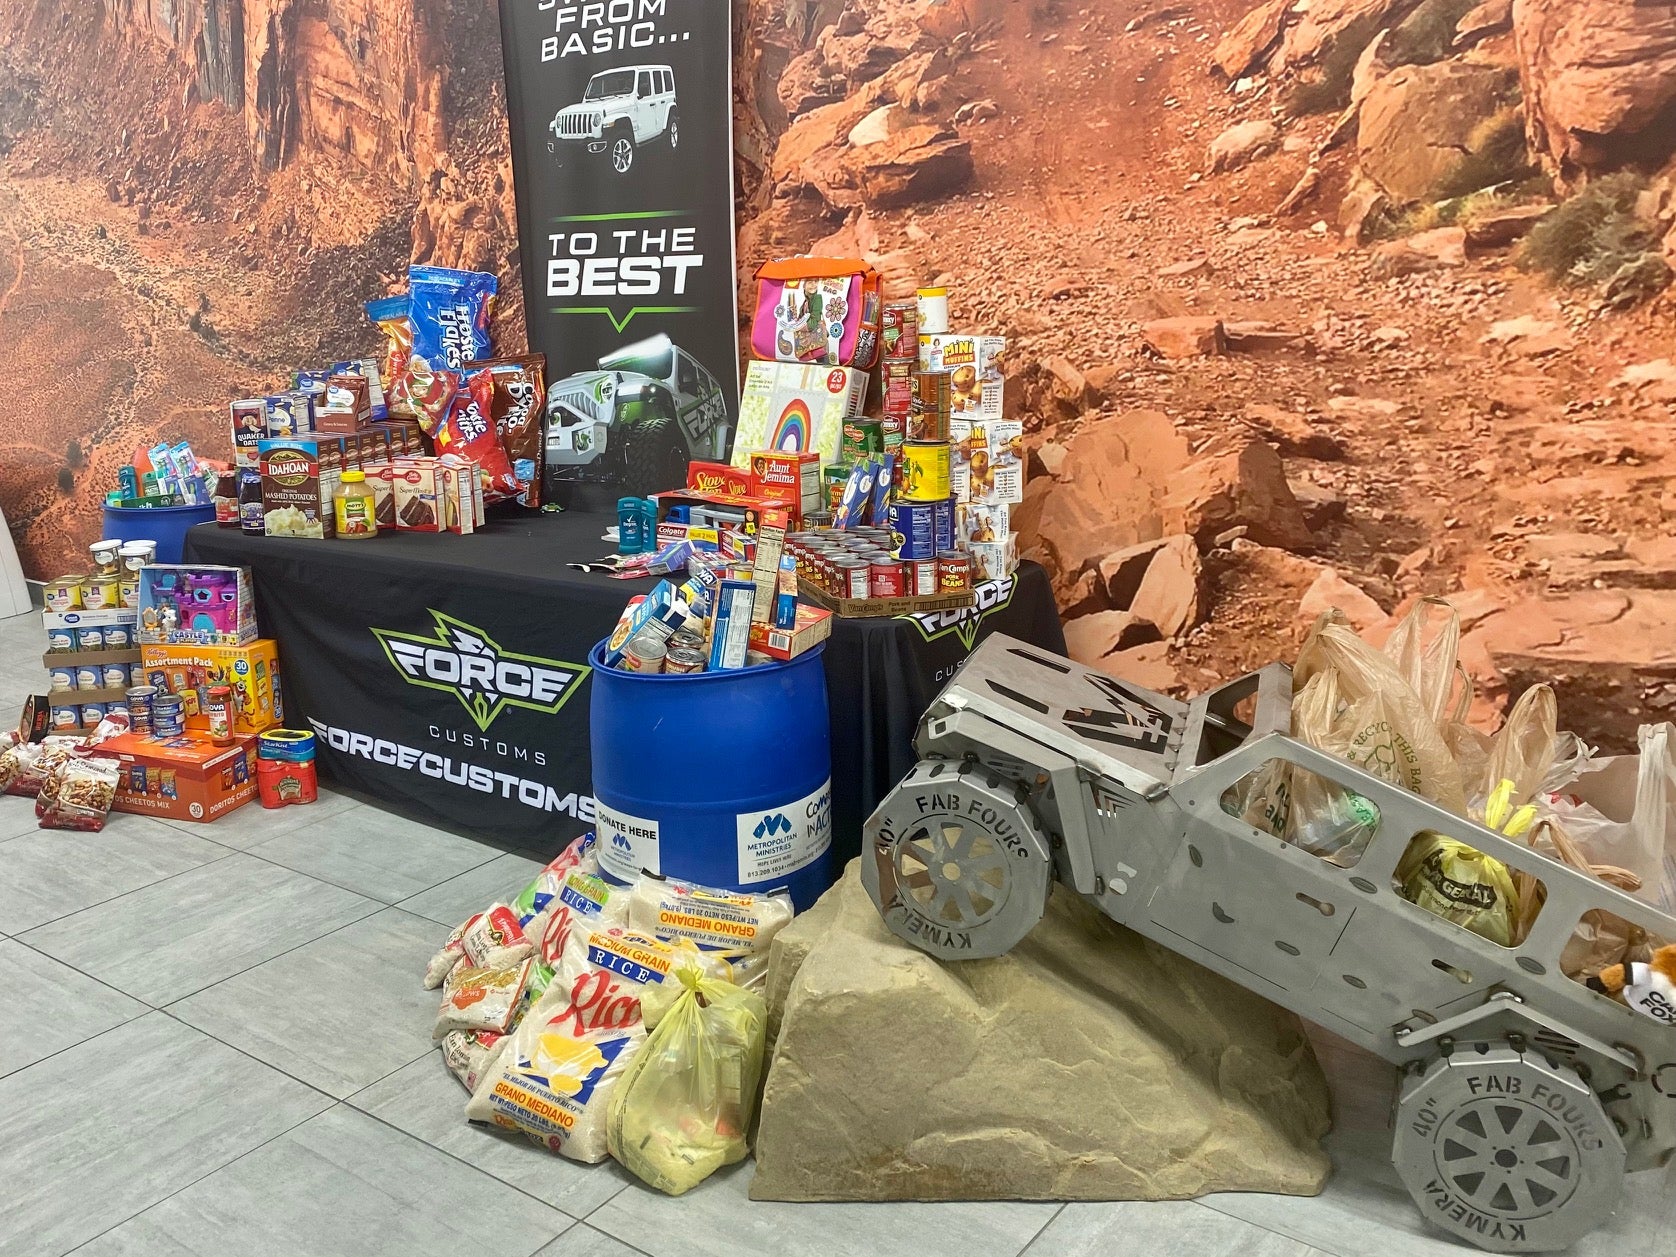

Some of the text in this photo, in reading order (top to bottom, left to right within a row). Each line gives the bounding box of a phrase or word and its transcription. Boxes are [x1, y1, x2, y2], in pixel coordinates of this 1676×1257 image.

[555, 0, 667, 33] FROM
[541, 22, 690, 62] BASIC...
[548, 227, 696, 256] TO THE
[547, 254, 703, 296] BEST
[439, 308, 461, 369] Flakes
[454, 302, 476, 362] Froste
[944, 353, 974, 365] MUFFINS
[831, 371, 843, 383] 23
[237, 432, 265, 441] QUAKER
[268, 462, 309, 475] IDAHOAN
[760, 473, 795, 484] Jemima
[769, 460, 790, 474] Aunt
[264, 491, 318, 501] MASHED POTATOES
[658, 526, 685, 536] Colgate
[941, 579, 965, 587] BEANS
[145, 656, 214, 668] Assortment Pack
[235, 661, 247, 670] 30
[387, 639, 573, 703] FORCE
[429, 725, 547, 766] CUSTOMS
[1353, 721, 1393, 746] RECYC
[1393, 732, 1418, 765] THIS
[1410, 767, 1423, 795] BAG
[125, 796, 156, 807] CHEETOS
[156, 799, 170, 809] MIX
[191, 805, 201, 814] 30
[209, 784, 259, 814] DORITOS CHEETO
[598, 809, 657, 840] DONATE HERE
[915, 793, 1029, 860] FAB FOURS
[747, 832, 798, 851] METROPOLITAN
[755, 842, 792, 857] MINISTRIES
[567, 874, 586, 892] LONG
[563, 888, 594, 913] RICE
[660, 911, 756, 938] GRANO MEDIANO
[704, 909, 723, 920] NETO
[747, 917, 759, 926] NET
[588, 934, 671, 974] MEDIUM GRAIN
[595, 949, 651, 984] RICE
[547, 969, 643, 1038] Rico
[1639, 998, 1676, 1026] FOX
[494, 1081, 575, 1129] GRANO MEDIANO
[1466, 1075, 1604, 1152] FAB FOURS
[1423, 1178, 1527, 1242] KYMERA
